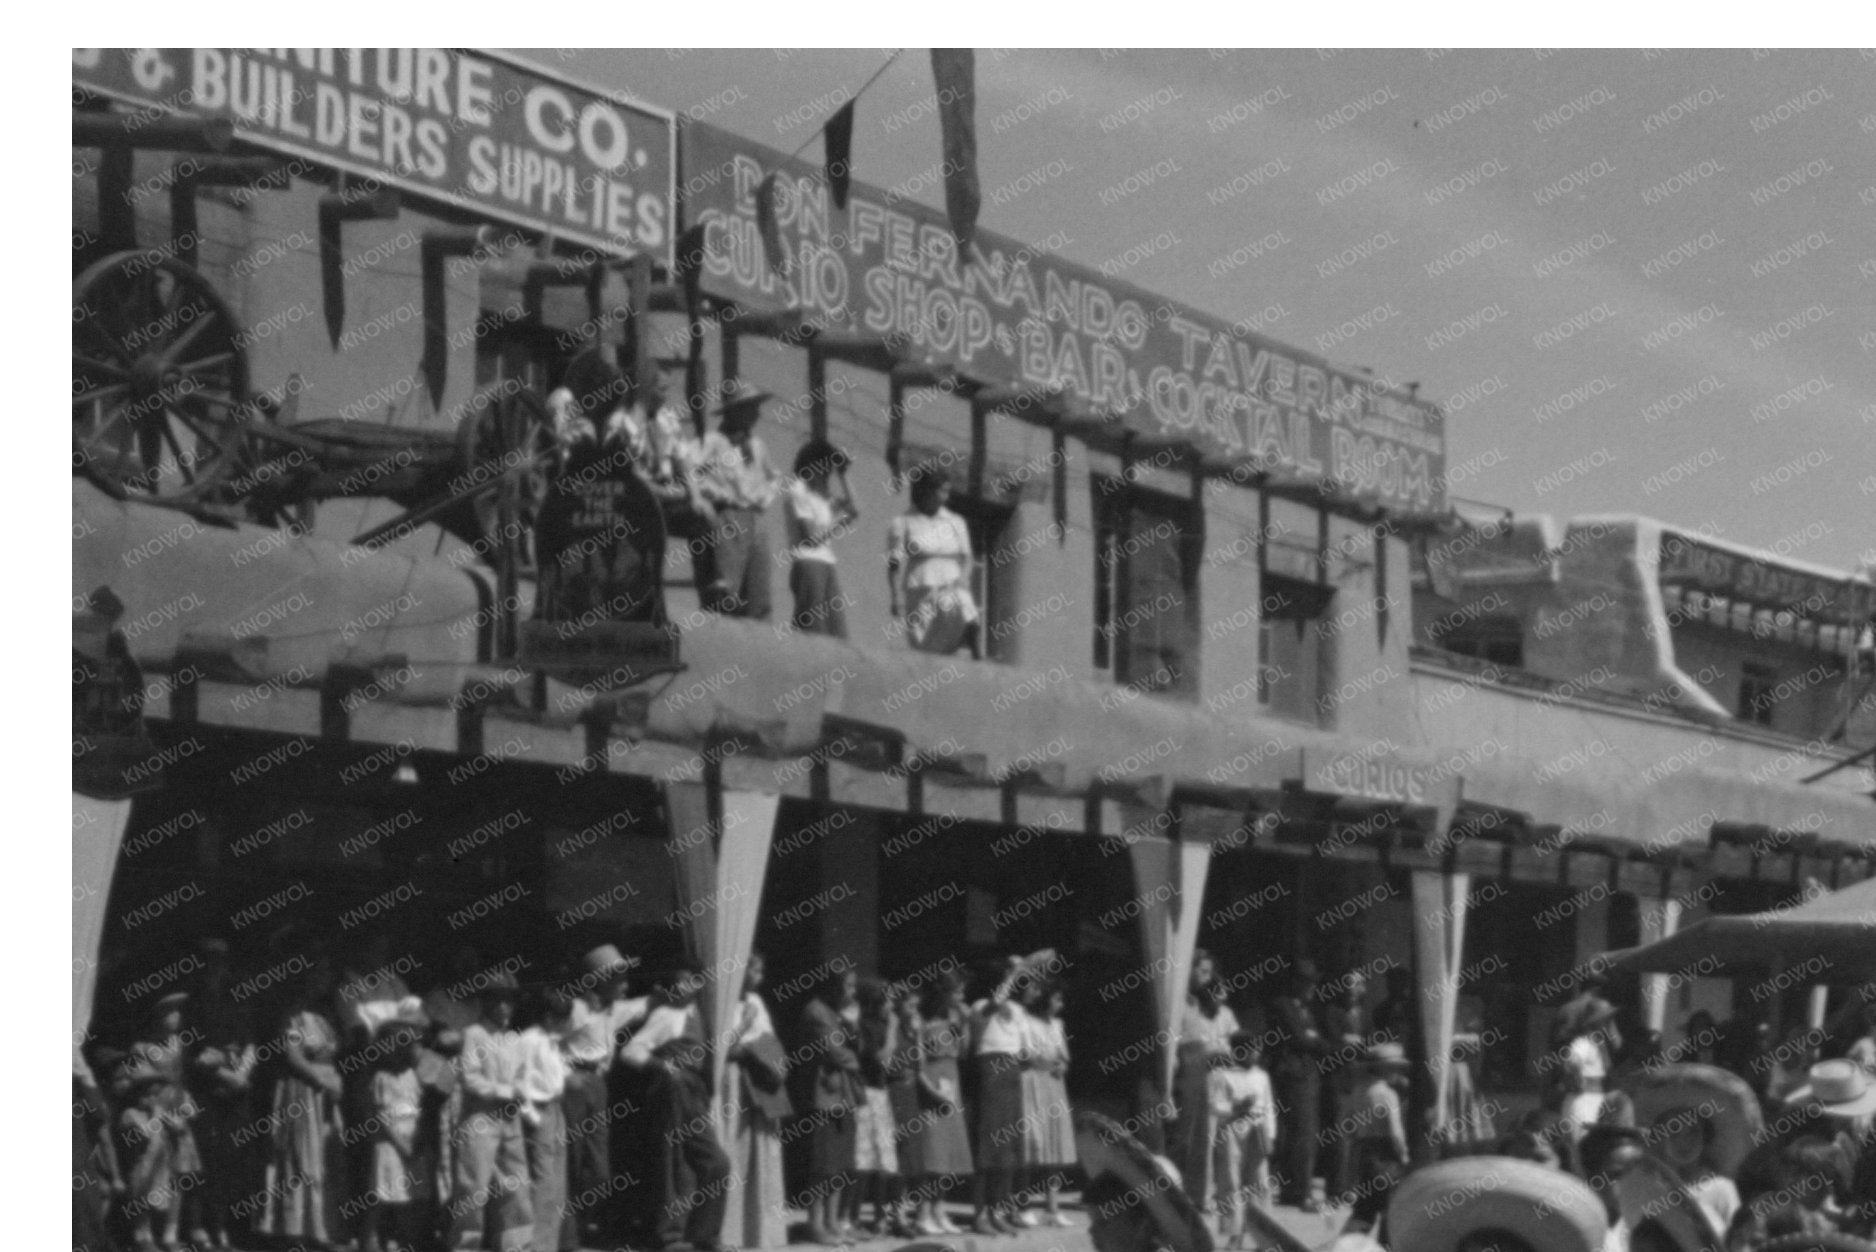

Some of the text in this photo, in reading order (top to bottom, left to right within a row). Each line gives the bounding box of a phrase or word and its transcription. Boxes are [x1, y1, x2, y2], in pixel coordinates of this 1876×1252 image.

[194, 48, 447, 178] BUILDERS
[468, 136, 664, 246] SUPPLIES
[525, 86, 648, 170] CO.
[851, 198, 1147, 350] FERNANDO
[1169, 316, 1362, 430] TAVERN
[865, 267, 992, 362] SHOP
[1020, 317, 1129, 414] BAR
[1149, 365, 1323, 476] COCKTAIL
[1331, 426, 1430, 508] ROOM
[1329, 756, 1430, 804] CURIOS
